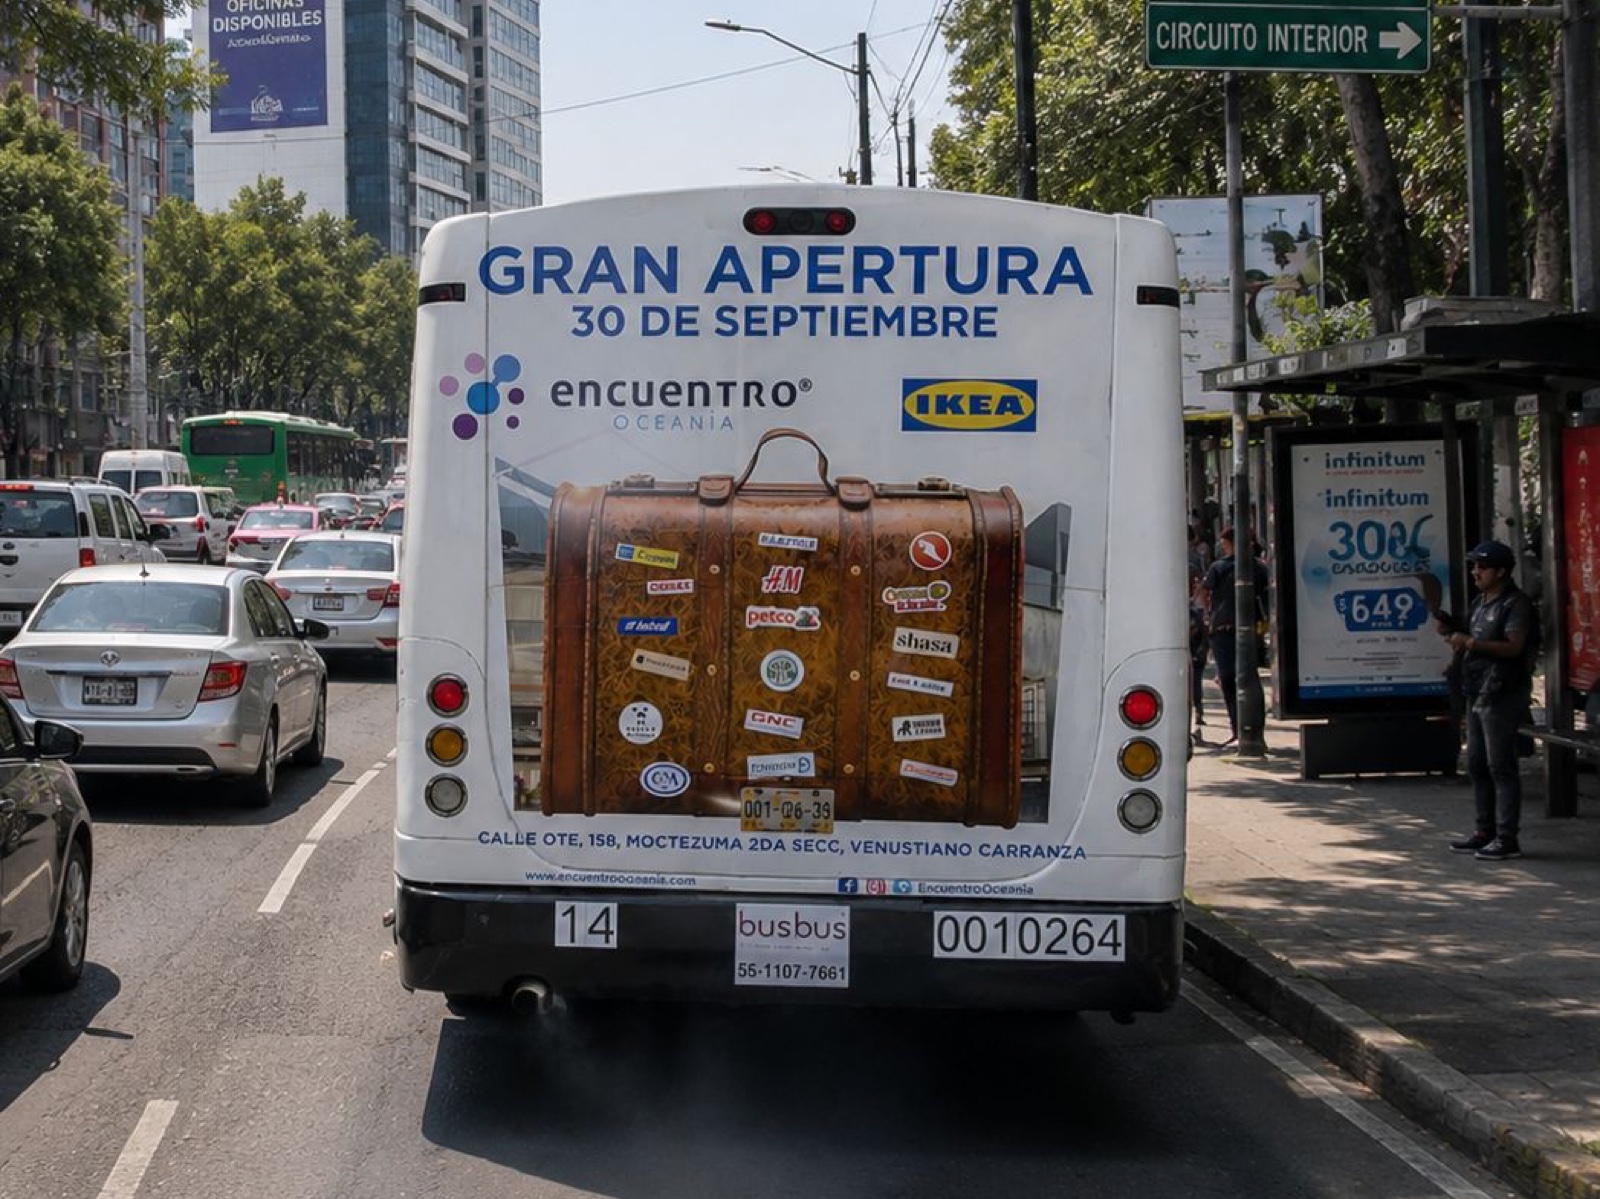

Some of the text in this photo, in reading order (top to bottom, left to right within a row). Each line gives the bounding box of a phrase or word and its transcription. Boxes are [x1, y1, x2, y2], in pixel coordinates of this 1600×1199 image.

[213, 10, 322, 32] DISPONIBLES
[1156, 22, 1368, 53] CIRCUITO INTERIOR
[478, 245, 1094, 295] GRAN APERTURA
[571, 305, 998, 337] 30 DE SEPTIEMBRE
[916, 394, 1025, 415] IKEA
[1325, 452, 1425, 469] infinitum
[1325, 488, 1429, 508] infinitum
[748, 609, 796, 626] petco
[896, 632, 952, 653] shasa
[751, 711, 797, 728] GNC
[478, 831, 1086, 860] CALLE OTE, 158, MOCTEZUMA 2DA SECC, VENUSTIANO CARRANZA
[561, 904, 614, 944] 14
[739, 910, 847, 941] busbus
[936, 915, 1122, 956] 0010264
